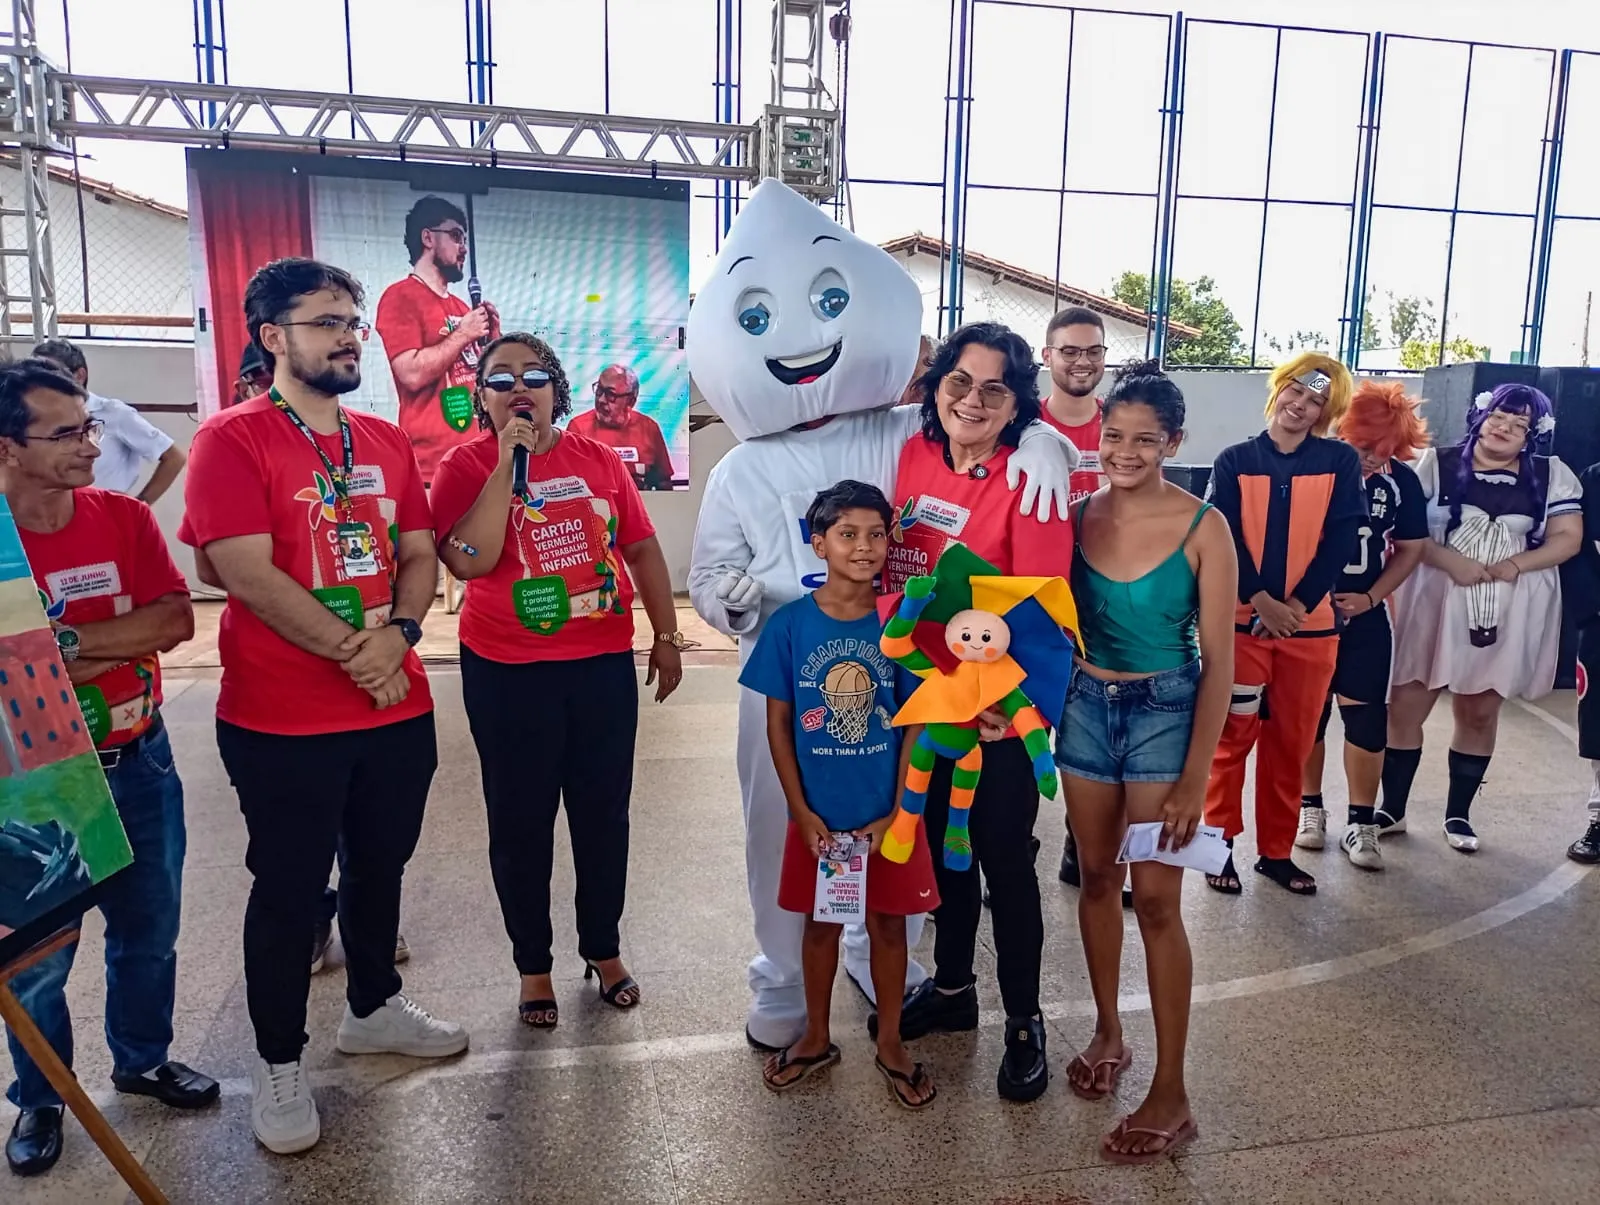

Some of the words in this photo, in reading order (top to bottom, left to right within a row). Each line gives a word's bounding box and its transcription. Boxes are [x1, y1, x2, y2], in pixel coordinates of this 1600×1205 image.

[559, 481, 580, 489] JUNHO
[932, 504, 940, 512] DE
[940, 508, 958, 518] JUNHO
[531, 518, 583, 541] CARTÃO
[534, 531, 586, 552] VERMELHO
[539, 551, 549, 561] AO
[550, 543, 588, 559] TRABALHO
[887, 547, 928, 565] CARTÃO
[541, 551, 593, 573] INFANTIL
[887, 560, 928, 576] VERMELHO
[68, 576, 78, 584] DE
[81, 570, 107, 582] JUNHO
[521, 586, 555, 597] Combater
[529, 594, 560, 607] proteger.
[525, 603, 560, 614] Denunciar
[800, 638, 893, 680] CHAMPIONS
[812, 747, 833, 755] MORE
[859, 747, 865, 755] A
[867, 742, 888, 755] SPORT
